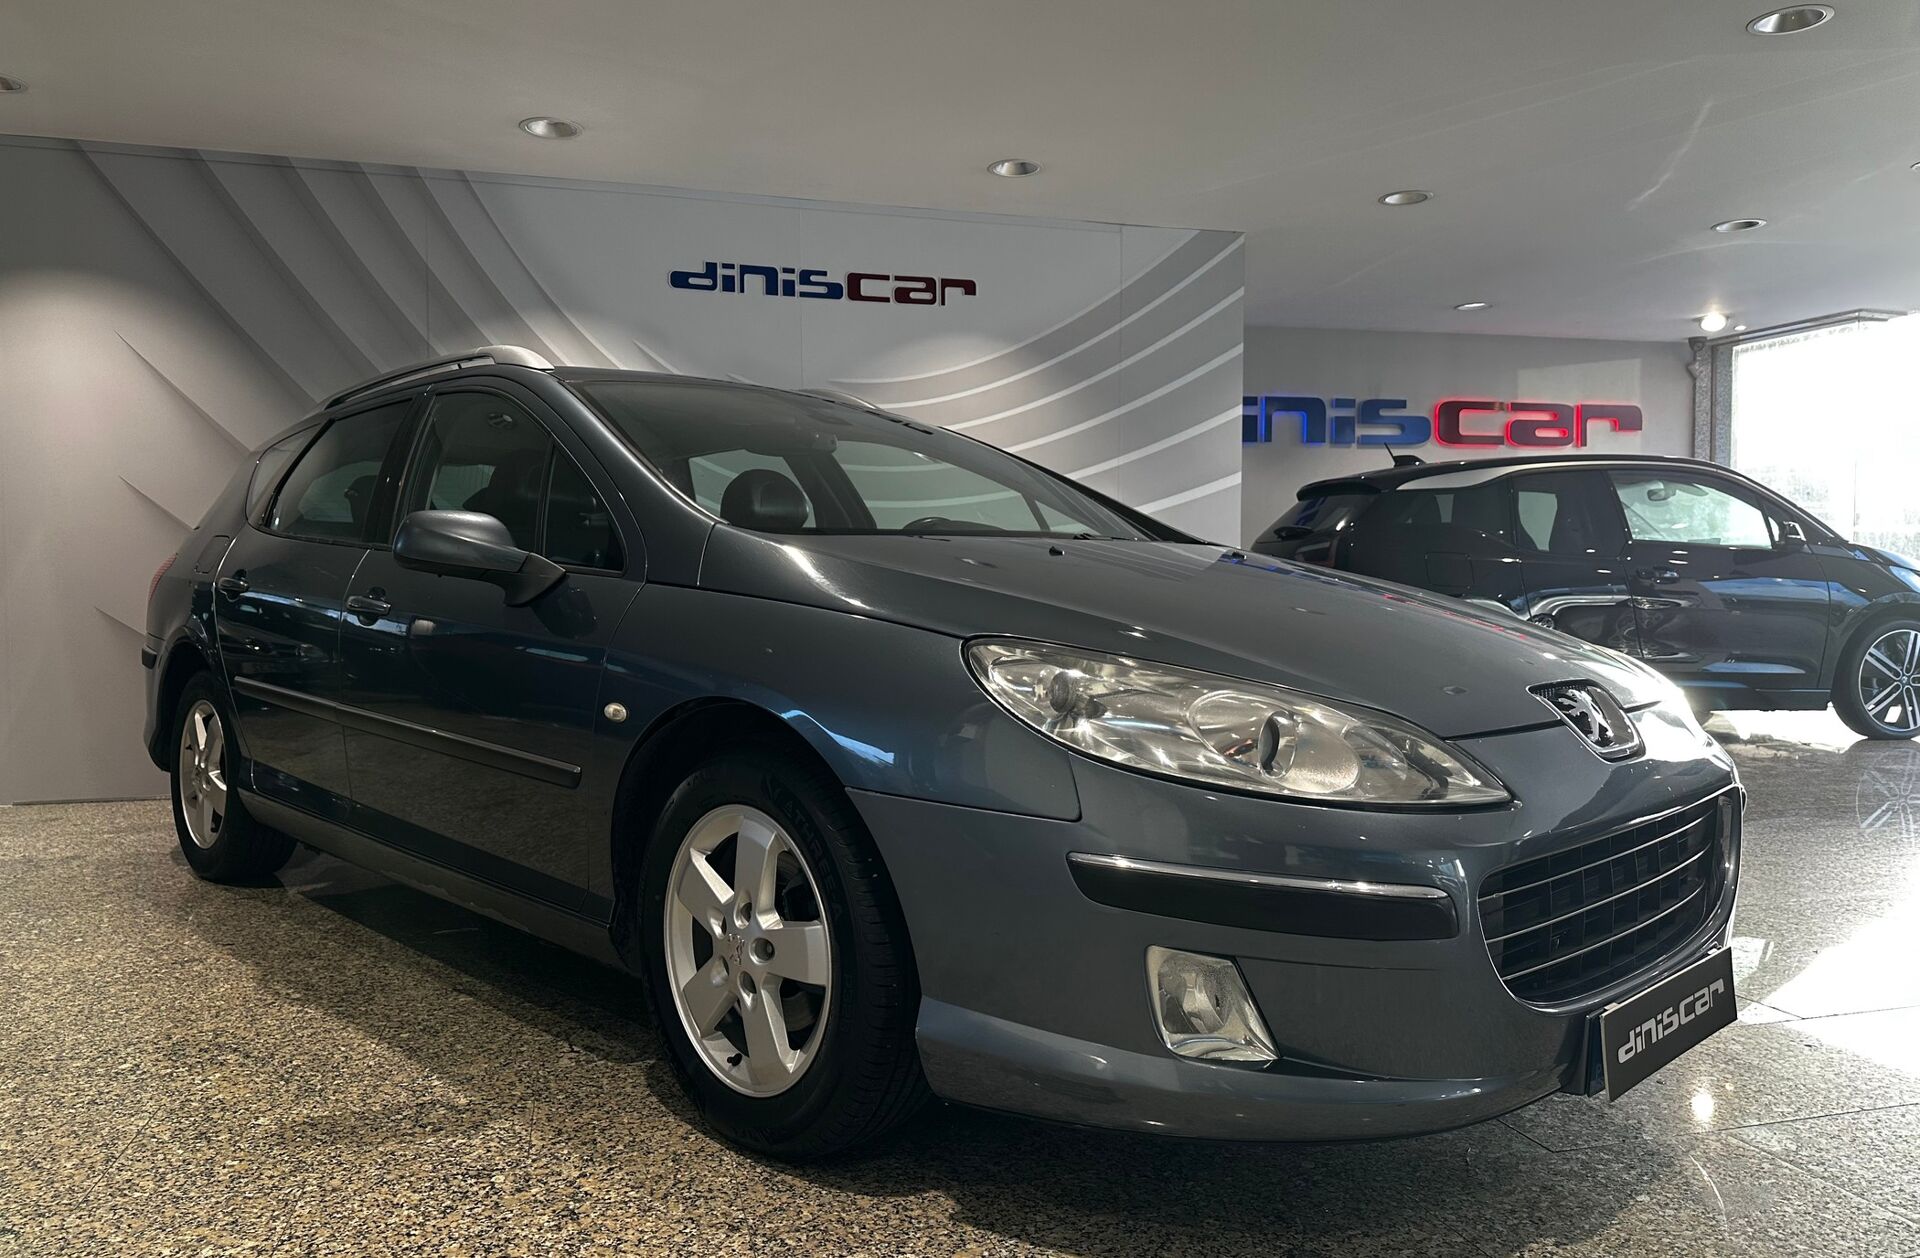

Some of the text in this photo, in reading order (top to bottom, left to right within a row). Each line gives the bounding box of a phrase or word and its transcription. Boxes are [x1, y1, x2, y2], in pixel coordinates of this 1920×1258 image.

[669, 261, 977, 306] diniscar
[1242, 396, 1643, 447] iniscar
[1617, 978, 1725, 1064] diniscar
